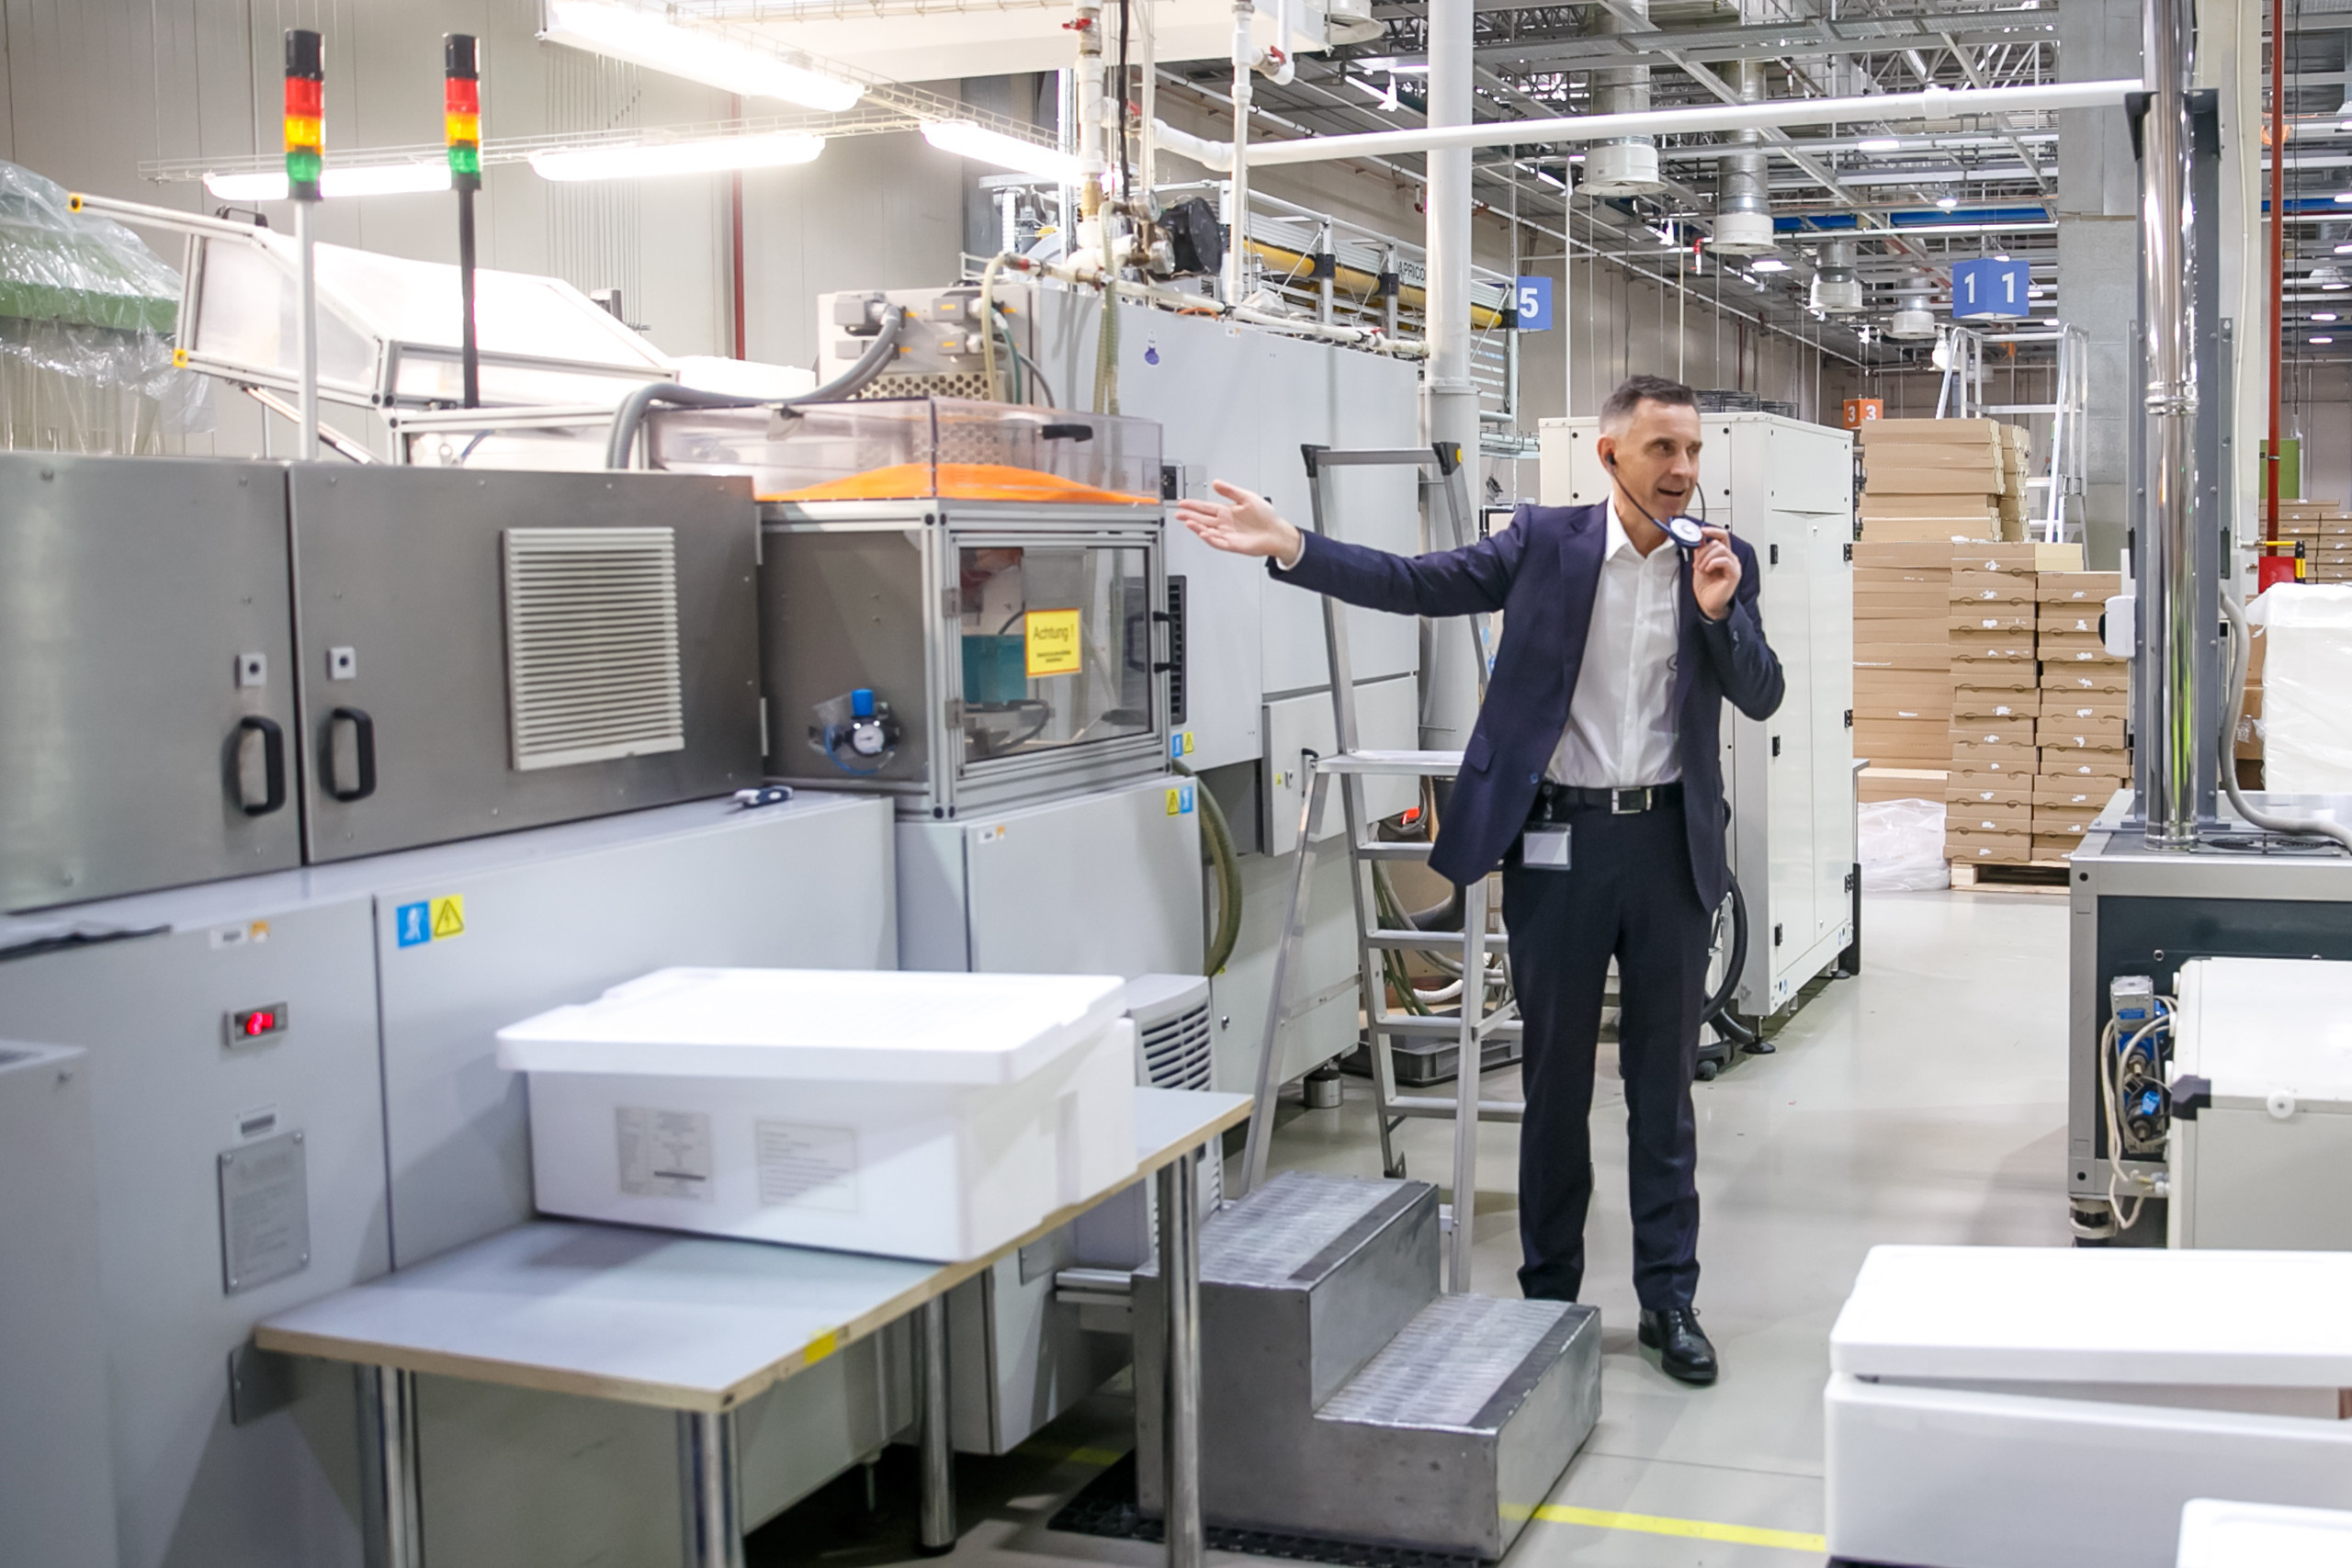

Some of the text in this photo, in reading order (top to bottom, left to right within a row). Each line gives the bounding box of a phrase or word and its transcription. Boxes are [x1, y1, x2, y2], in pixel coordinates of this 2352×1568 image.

[1964, 272, 1974, 303] 1
[2002, 272, 2014, 303] 1
[1520, 288, 1539, 318] 5
[1848, 405, 1856, 423] 3
[1866, 404, 1876, 420] 3
[1034, 626, 1069, 642] Achtung
